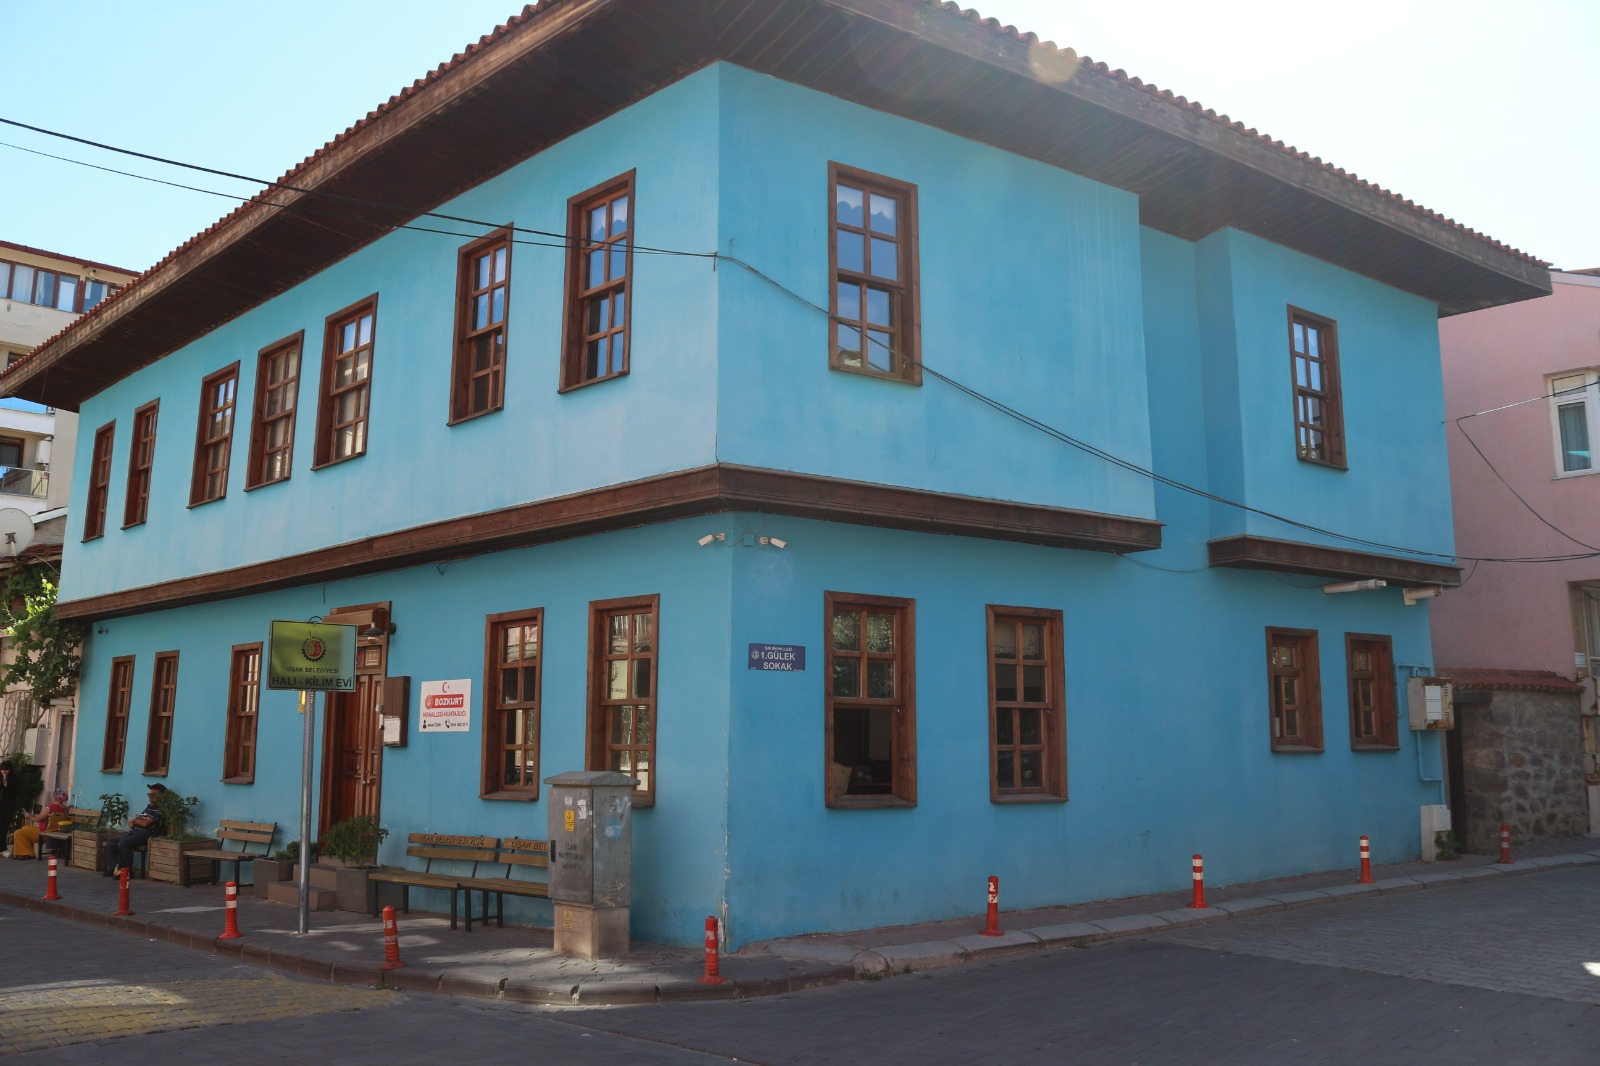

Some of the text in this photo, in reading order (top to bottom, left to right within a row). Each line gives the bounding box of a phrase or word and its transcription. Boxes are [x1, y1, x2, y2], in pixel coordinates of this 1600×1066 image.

[286, 666, 304, 674] UŞAK
[763, 661, 792, 671] SOKAK
[271, 676, 297, 686] HALI
[305, 676, 333, 687] KİLİM
[336, 676, 352, 688] EVİ
[434, 696, 463, 706] BOZKURT
[469, 836, 485, 847] 2024
[511, 840, 532, 850] UŞAK
